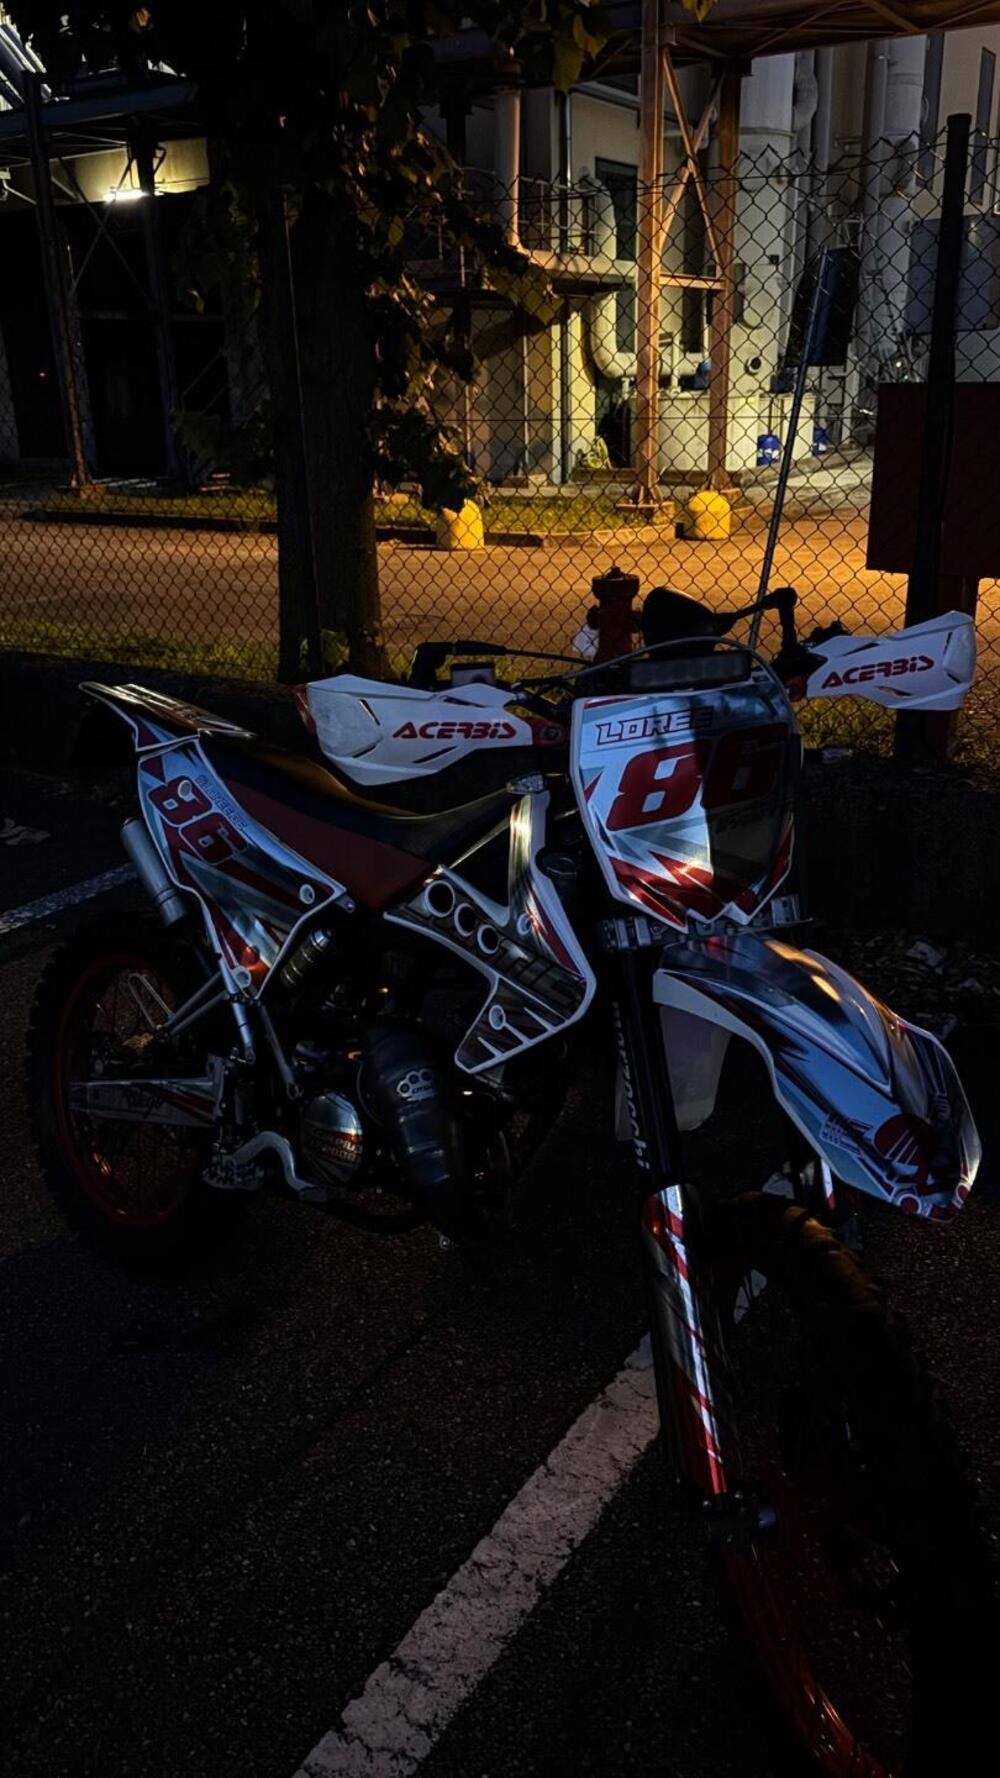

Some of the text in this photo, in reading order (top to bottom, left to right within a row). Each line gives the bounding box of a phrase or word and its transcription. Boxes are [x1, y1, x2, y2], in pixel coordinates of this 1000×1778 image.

[822, 655, 935, 689] ACERBIS
[393, 721, 517, 742] ACERBIS
[605, 722, 789, 831] 86
[148, 775, 249, 866] 86
